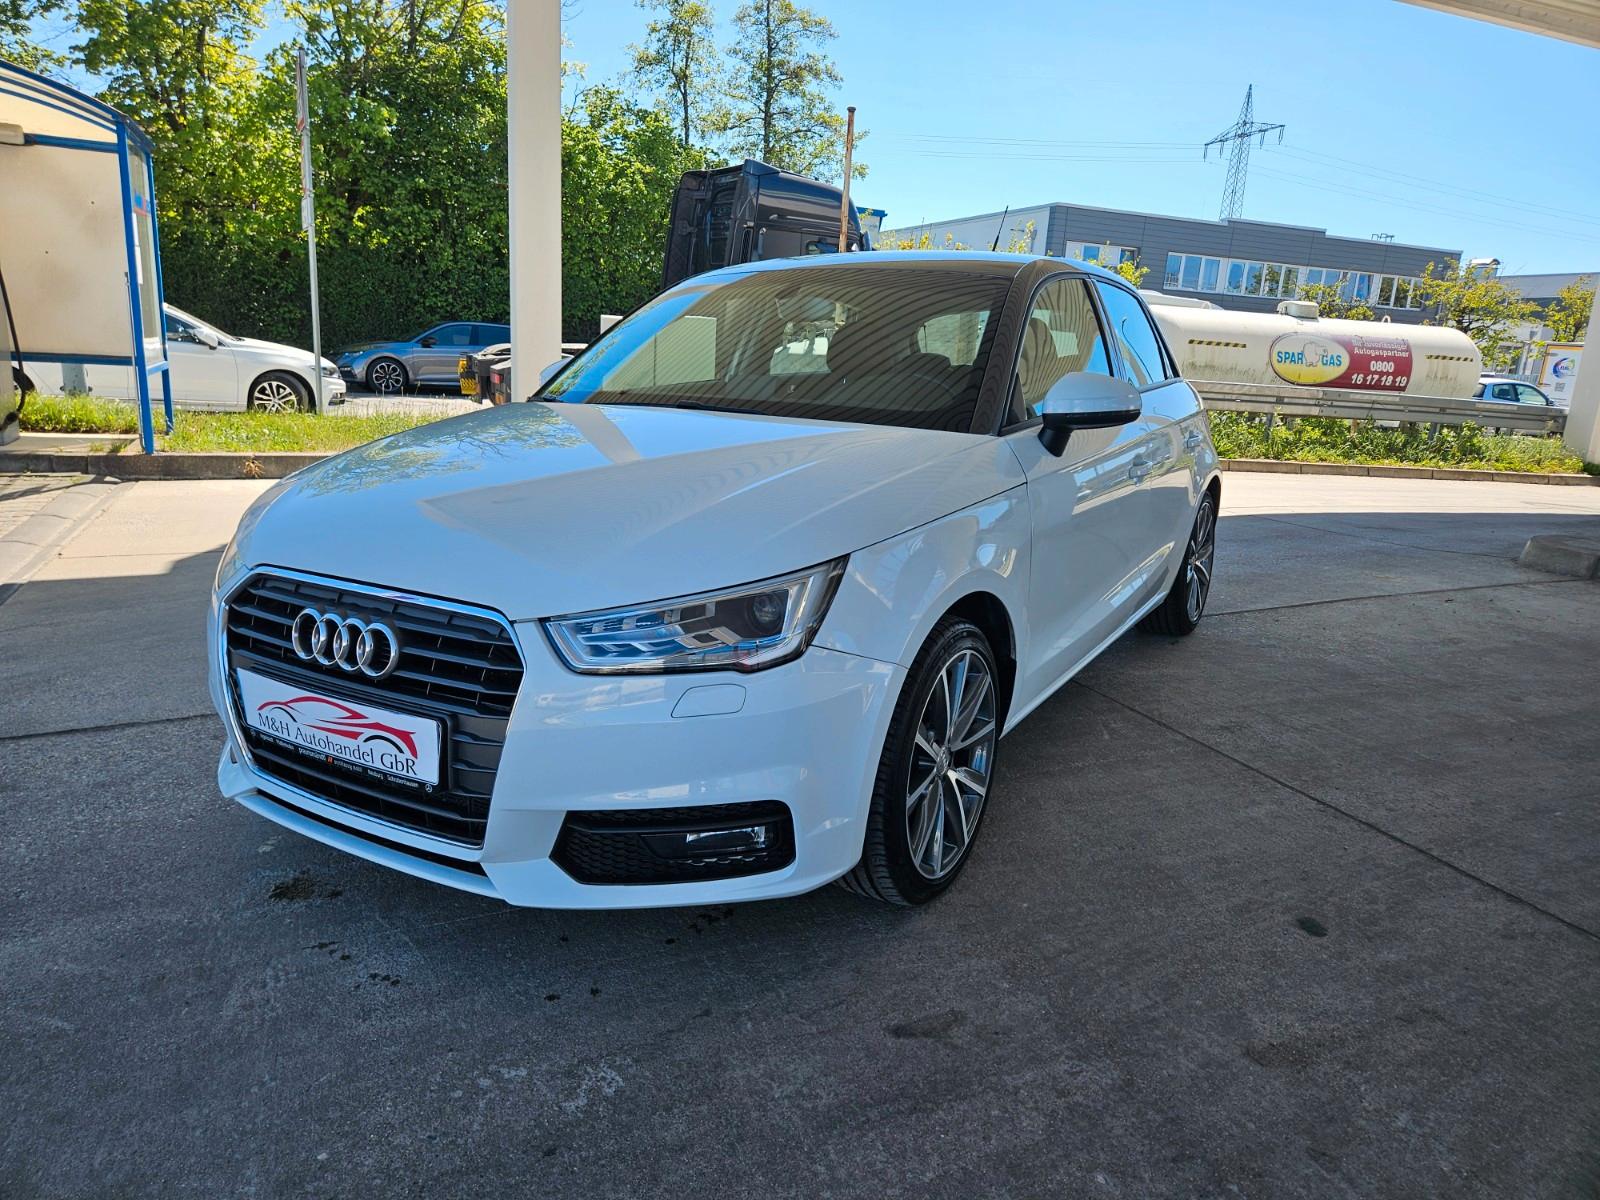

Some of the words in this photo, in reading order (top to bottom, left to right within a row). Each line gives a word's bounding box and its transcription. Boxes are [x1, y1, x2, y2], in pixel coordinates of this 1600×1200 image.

[1276, 351, 1304, 364] SPAR
[1321, 354, 1342, 366] GAS
[1354, 347, 1409, 357] Autogaspartner
[1370, 361, 1394, 372] 0800
[1351, 373, 1364, 384] 16
[1366, 374, 1379, 385] 17
[1381, 375, 1393, 386] 18
[1395, 376, 1407, 387] 19
[258, 712, 290, 737] M&H
[295, 726, 374, 764] Autohandel
[380, 752, 417, 776] GbR
